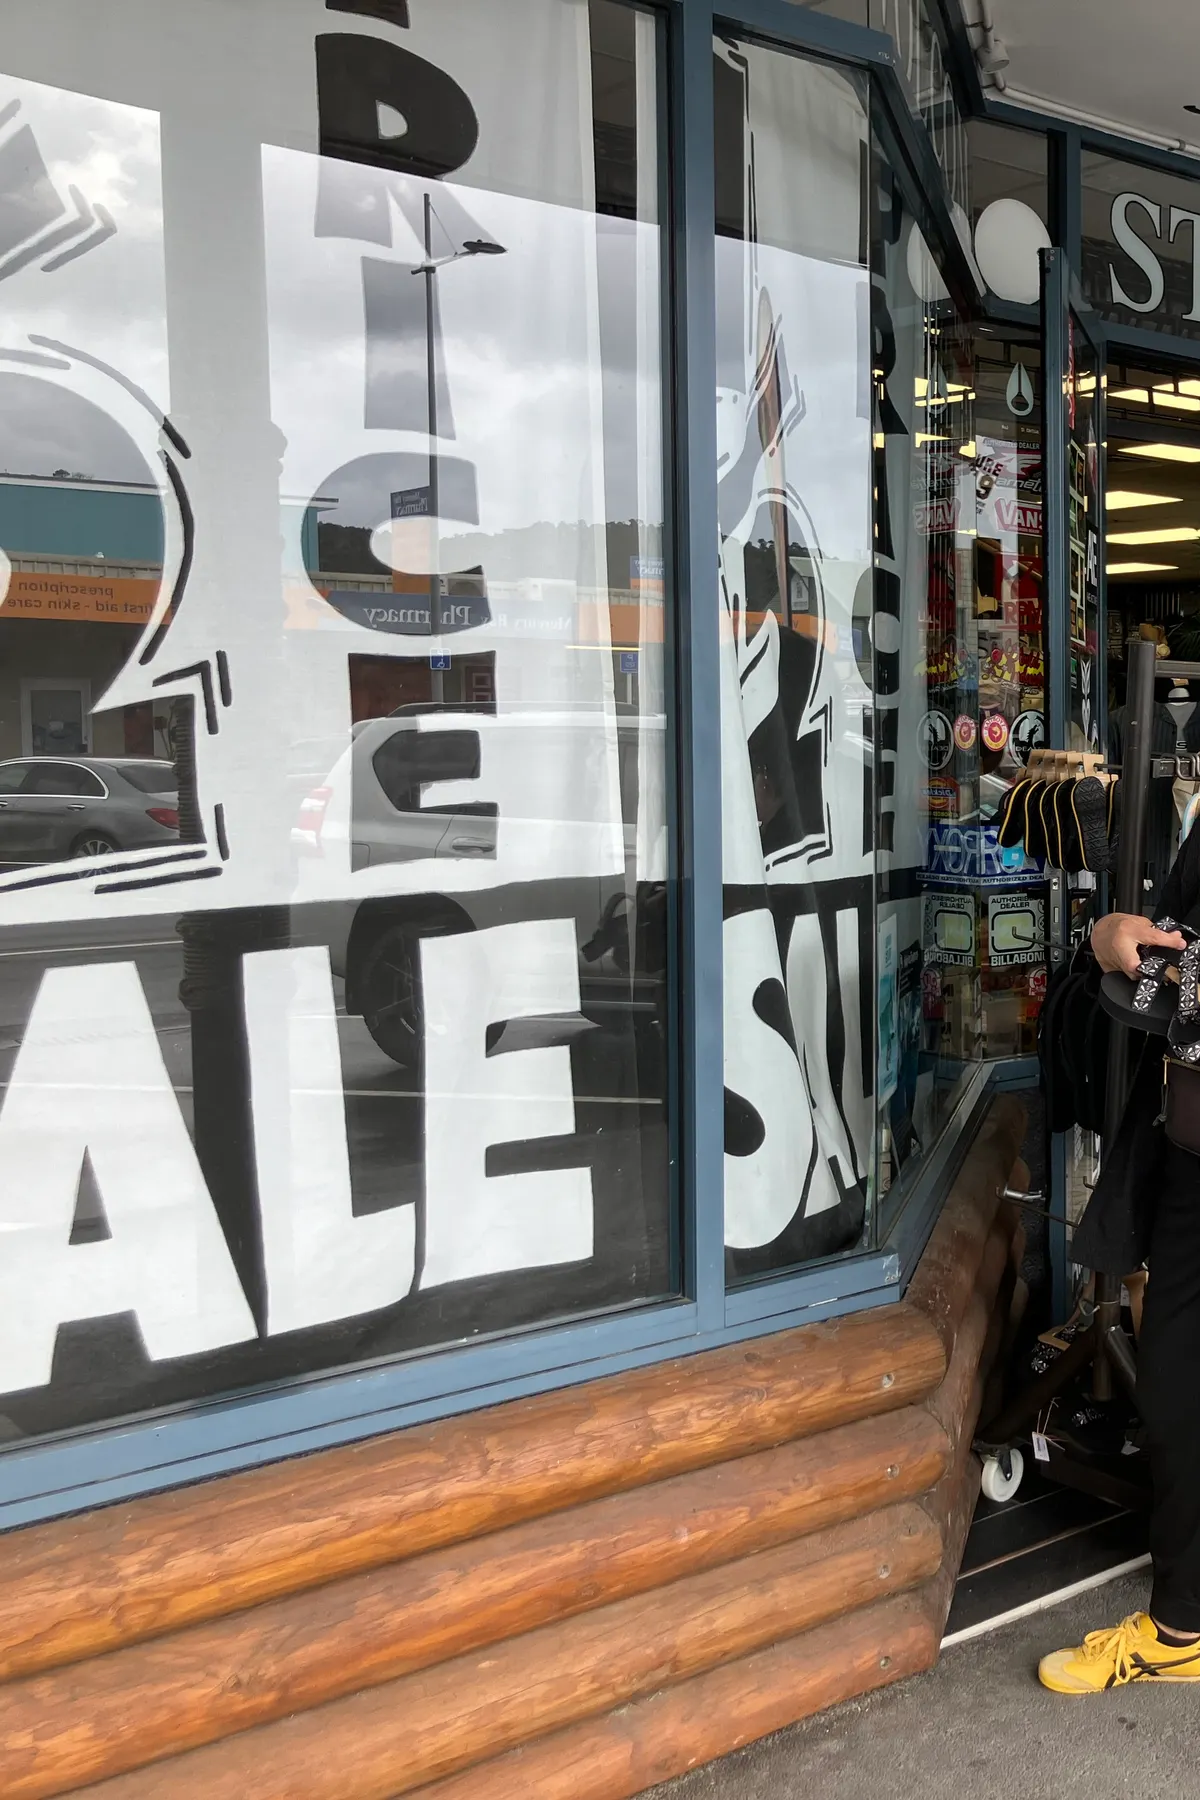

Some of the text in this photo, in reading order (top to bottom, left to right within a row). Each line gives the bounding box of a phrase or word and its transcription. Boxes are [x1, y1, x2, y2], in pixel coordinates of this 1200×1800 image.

[302, 0, 498, 873] RICE
[990, 951, 1044, 967] BILLABON
[1000, 900, 1030, 910] DEALER
[0, 918, 595, 1393] ALE
